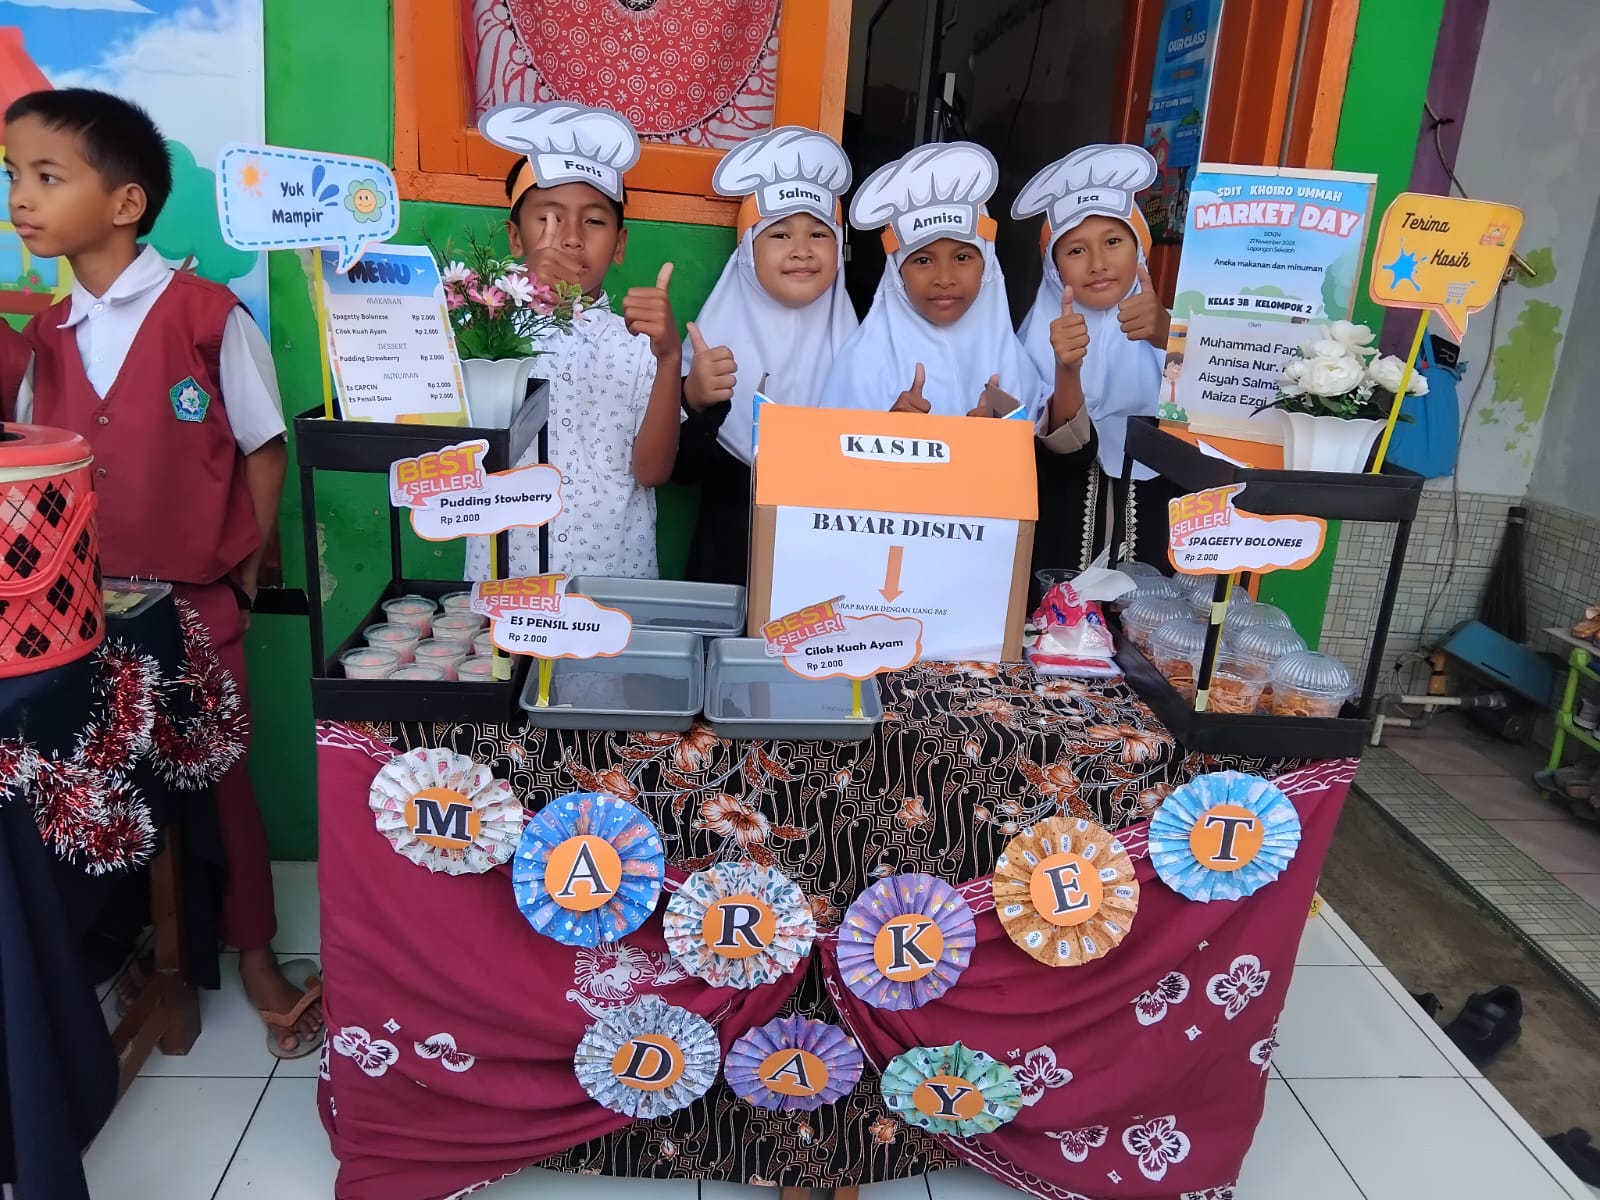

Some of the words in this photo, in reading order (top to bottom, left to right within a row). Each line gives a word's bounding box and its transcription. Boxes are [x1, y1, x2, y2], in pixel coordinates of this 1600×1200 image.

[563, 159, 603, 178] Faris
[280, 181, 304, 199] Yuk
[778, 187, 822, 203] Salma
[1217, 186, 1242, 198] SDIT
[1250, 185, 1293, 196] KHOIRO
[1297, 187, 1343, 202] UMMAH
[1077, 194, 1099, 205] Iza
[272, 208, 324, 227] Mampir
[912, 212, 963, 231] Annisa
[1196, 201, 1296, 229] MARKET
[1300, 205, 1359, 236] DAY
[1401, 212, 1451, 233] Terima
[1214, 258, 1236, 267] Aneka
[1237, 260, 1271, 269] makanan
[1271, 262, 1286, 270] dan
[1287, 263, 1323, 273] minuman
[1430, 248, 1471, 268] Kasih
[347, 260, 411, 285] MENU
[1208, 297, 1235, 306] KELAS
[1237, 298, 1249, 306] 3B
[1255, 299, 1303, 313] KELOMPOK
[1305, 305, 1313, 314] 2
[1248, 321, 1262, 329] Oleh
[1200, 336, 1271, 353] Muhammad
[1208, 355, 1250, 369] Annisa
[1252, 359, 1279, 373] Nur.
[1198, 372, 1239, 387] Aisyah
[1202, 390, 1236, 404] Maiza
[846, 436, 945, 459] KASIR
[399, 445, 483, 484] BEST
[410, 468, 483, 495] SELLER!
[440, 496, 491, 508] Pudding
[495, 493, 552, 504] Stowberry
[1170, 486, 1237, 525] BEST
[440, 516, 453, 525] Rp
[455, 513, 480, 523] 2.000
[811, 512, 895, 535] BAYAR
[901, 519, 986, 542] DISINI
[1174, 507, 1231, 536] SELLER!
[1188, 536, 1243, 547] SPAGEETY
[1245, 538, 1304, 548] BOLONESE
[1185, 554, 1195, 562] Rp
[1197, 553, 1218, 561] 2.000
[482, 573, 567, 596] BEST
[490, 594, 560, 611] SELLER!
[838, 602, 855, 610] RAP
[880, 605, 911, 613] DENGAN
[912, 607, 933, 615] UANG
[510, 615, 523, 626] ES
[526, 617, 569, 631] PENSIL
[572, 621, 601, 632] SUSU
[765, 600, 834, 639] BEST
[508, 632, 521, 643] Rp
[523, 633, 547, 643] 2.000
[779, 614, 845, 646] SELLER!
[805, 646, 834, 656] Cilok
[836, 643, 867, 653] Kuah
[869, 640, 904, 650] Ayam
[806, 662, 818, 671] Rp
[820, 660, 844, 669] 2.000
